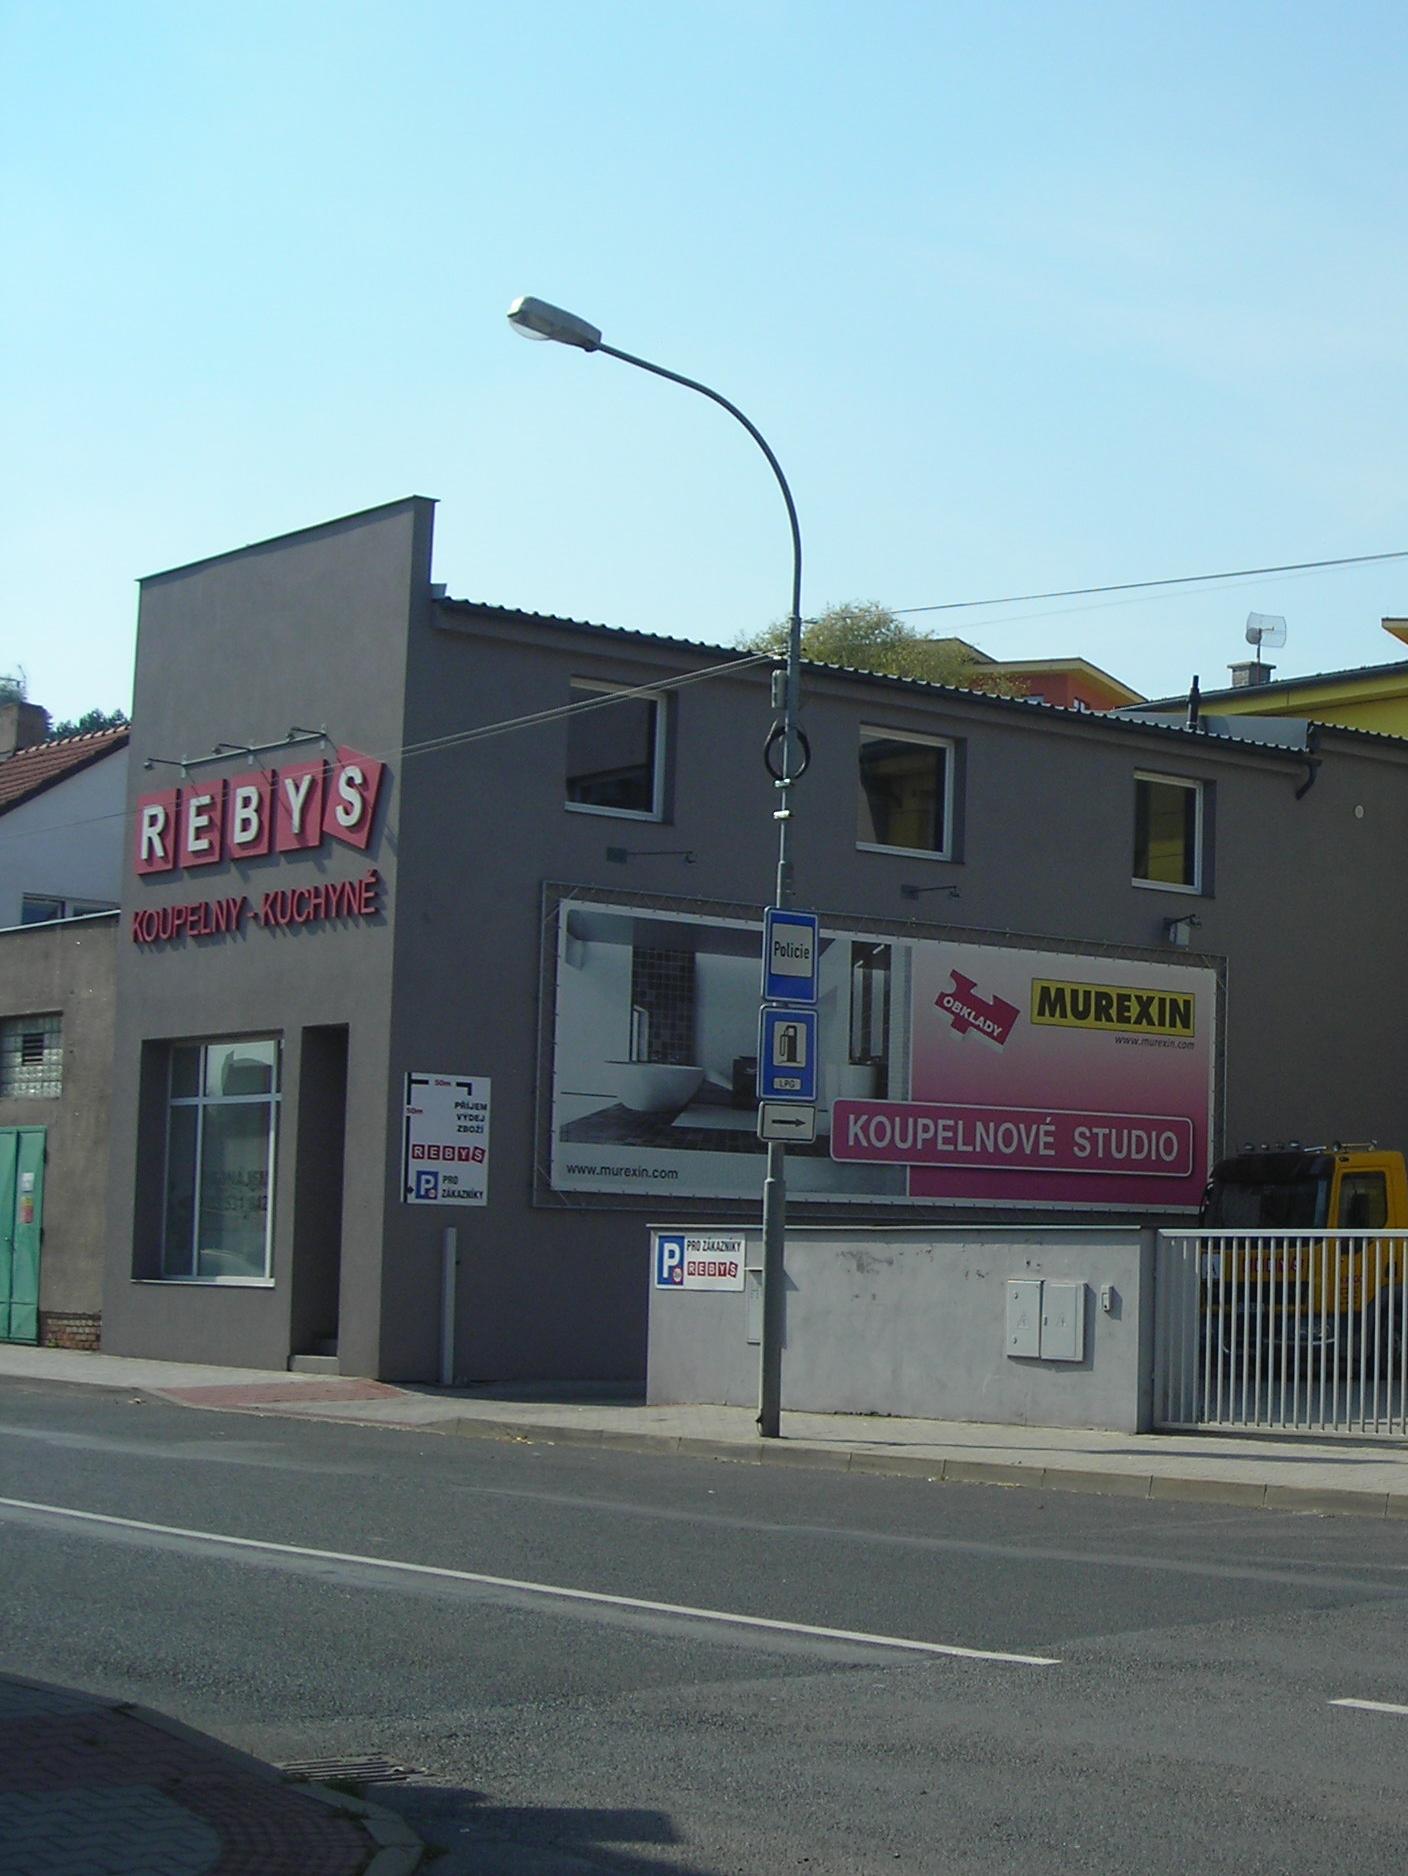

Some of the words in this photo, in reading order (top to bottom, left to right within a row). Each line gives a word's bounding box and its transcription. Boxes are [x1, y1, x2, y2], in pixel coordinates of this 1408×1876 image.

[140, 765, 365, 860] REBYS
[133, 896, 247, 943] KOUPELNY
[260, 869, 378, 926] KUCHYNĚ
[773, 940, 810, 960] Policie
[943, 994, 1003, 1038] OBKLADY
[1036, 985, 1192, 1030] MUREXIN
[1114, 1035, 1195, 1051] www.murexin.com
[848, 1114, 1056, 1156] KOUPELNOVÉ
[1073, 1126, 1178, 1162] STUDIO
[414, 1146, 483, 1160] REBYS
[442, 1175, 459, 1185] PRO
[566, 1162, 679, 1180] www.murexin.com
[686, 1240, 700, 1252] PRO
[688, 1261, 737, 1277] REBYS
